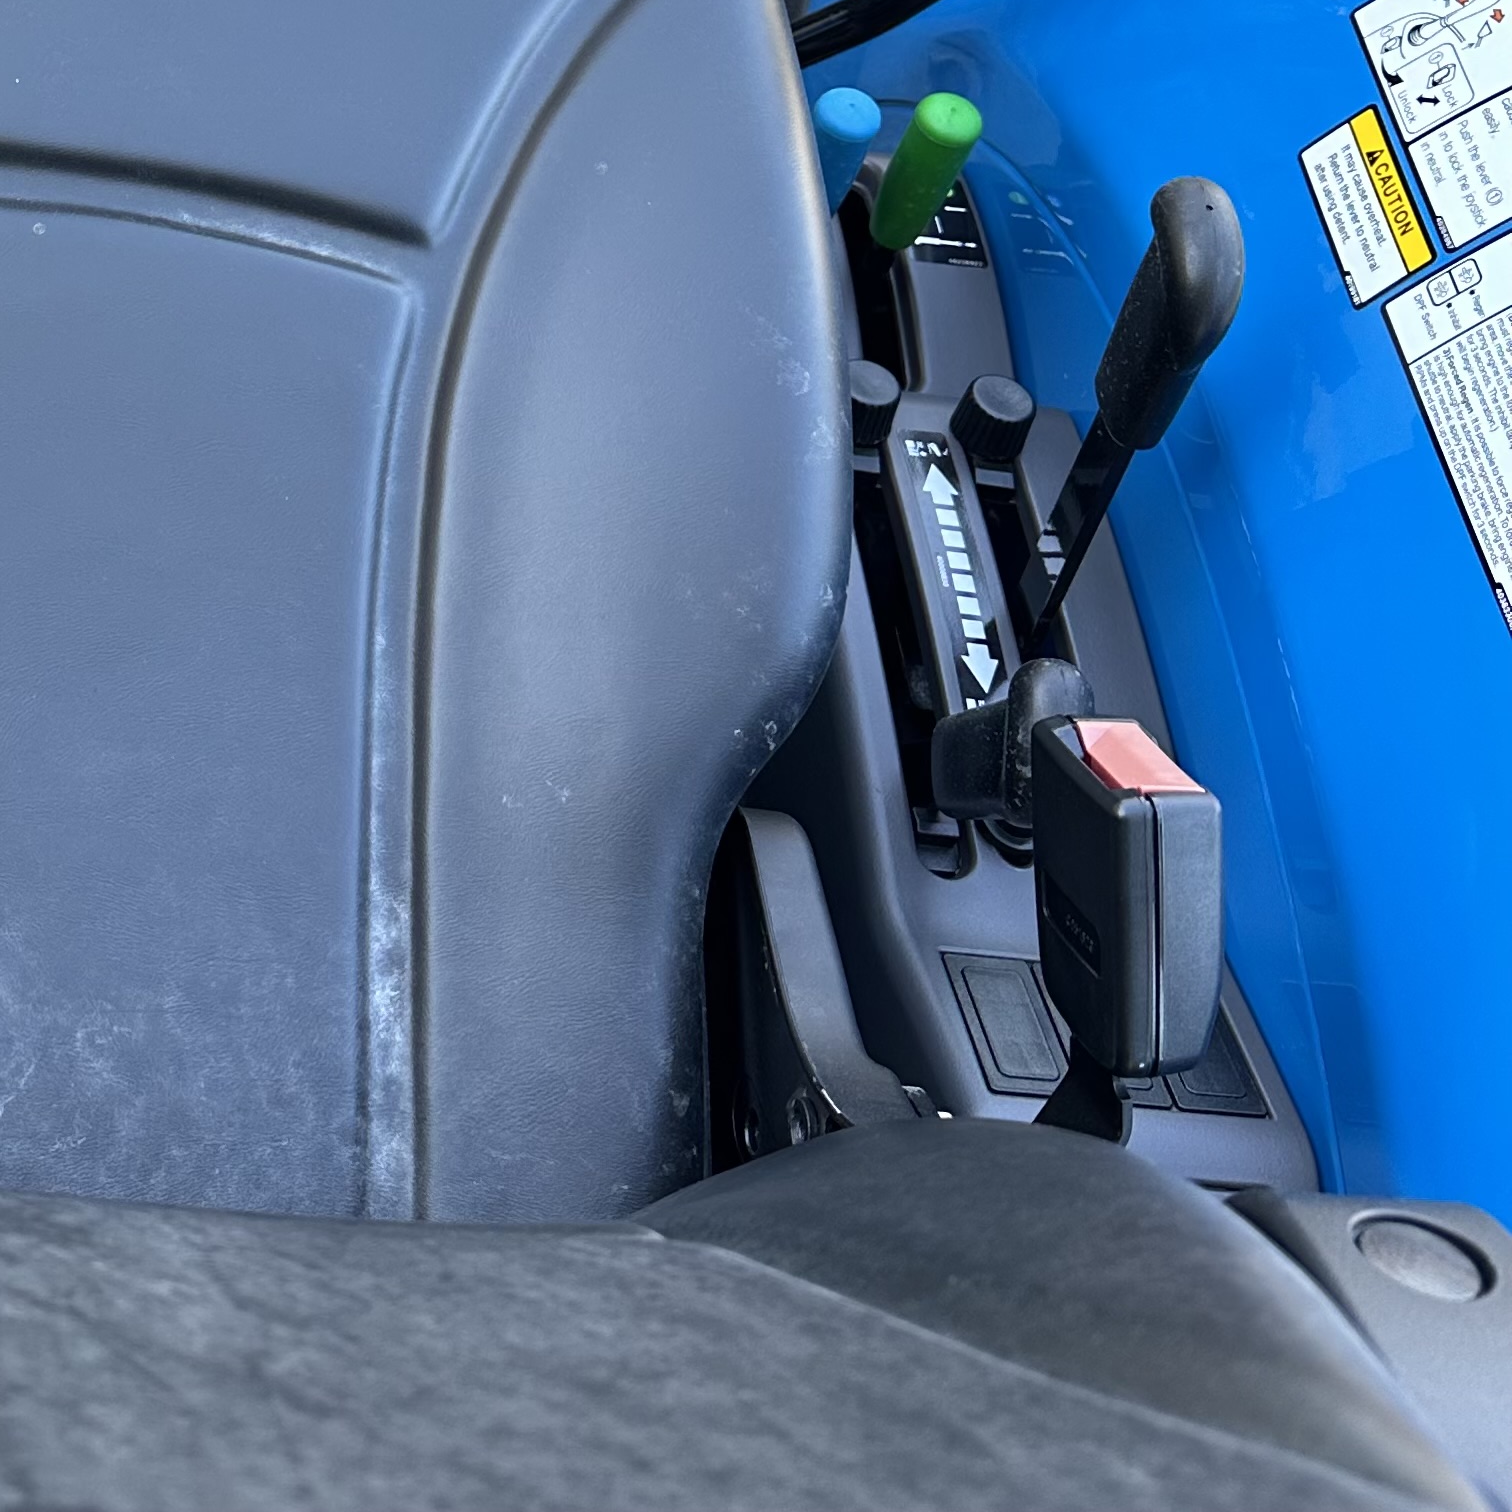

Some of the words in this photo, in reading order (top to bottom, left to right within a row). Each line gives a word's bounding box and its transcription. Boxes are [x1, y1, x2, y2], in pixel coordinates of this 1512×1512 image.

[1397, 89, 1416, 124] Unlock
[1441, 84, 1458, 108] Lock
[1340, 143, 1351, 153] It
[1420, 141, 1430, 152] in
[1438, 130, 1448, 141] in
[1442, 140, 1453, 153] to
[1344, 152, 1357, 173] may
[1448, 152, 1463, 174] lock
[1457, 119, 1473, 145] Push
[1467, 144, 1480, 161] the
[1475, 161, 1492, 185] lever
[1314, 163, 1327, 183] after
[1322, 184, 1337, 212] using
[1352, 173, 1368, 202] cause
[1457, 174, 1470, 191] the
[1327, 152, 1344, 185] Return
[1339, 183, 1350, 201] the
[1345, 200, 1360, 224] lever
[1354, 224, 1364, 237] to
[1359, 237, 1380, 272] neutral
[1375, 163, 1413, 236] CAUTION
[1462, 191, 1486, 228] joystick
[1413, 293, 1427, 310] DPF
[1421, 312, 1437, 340] Switch
[1458, 384, 1473, 414] Regen
[1488, 386, 1499, 404] The
[1473, 422, 1481, 433] is
[1423, 388, 1435, 404] and
[1447, 448, 1457, 463] the
[1471, 507, 1481, 520] for
[1458, 445, 1468, 460] the
[1475, 432, 1495, 467] possible
[1460, 422, 1481, 462] automatic
[1499, 515, 1509, 529] To
[1461, 460, 1481, 493] parking
[1491, 465, 1499, 476] to
[1495, 475, 1509, 498] force
[1487, 517, 1502, 543] bring
